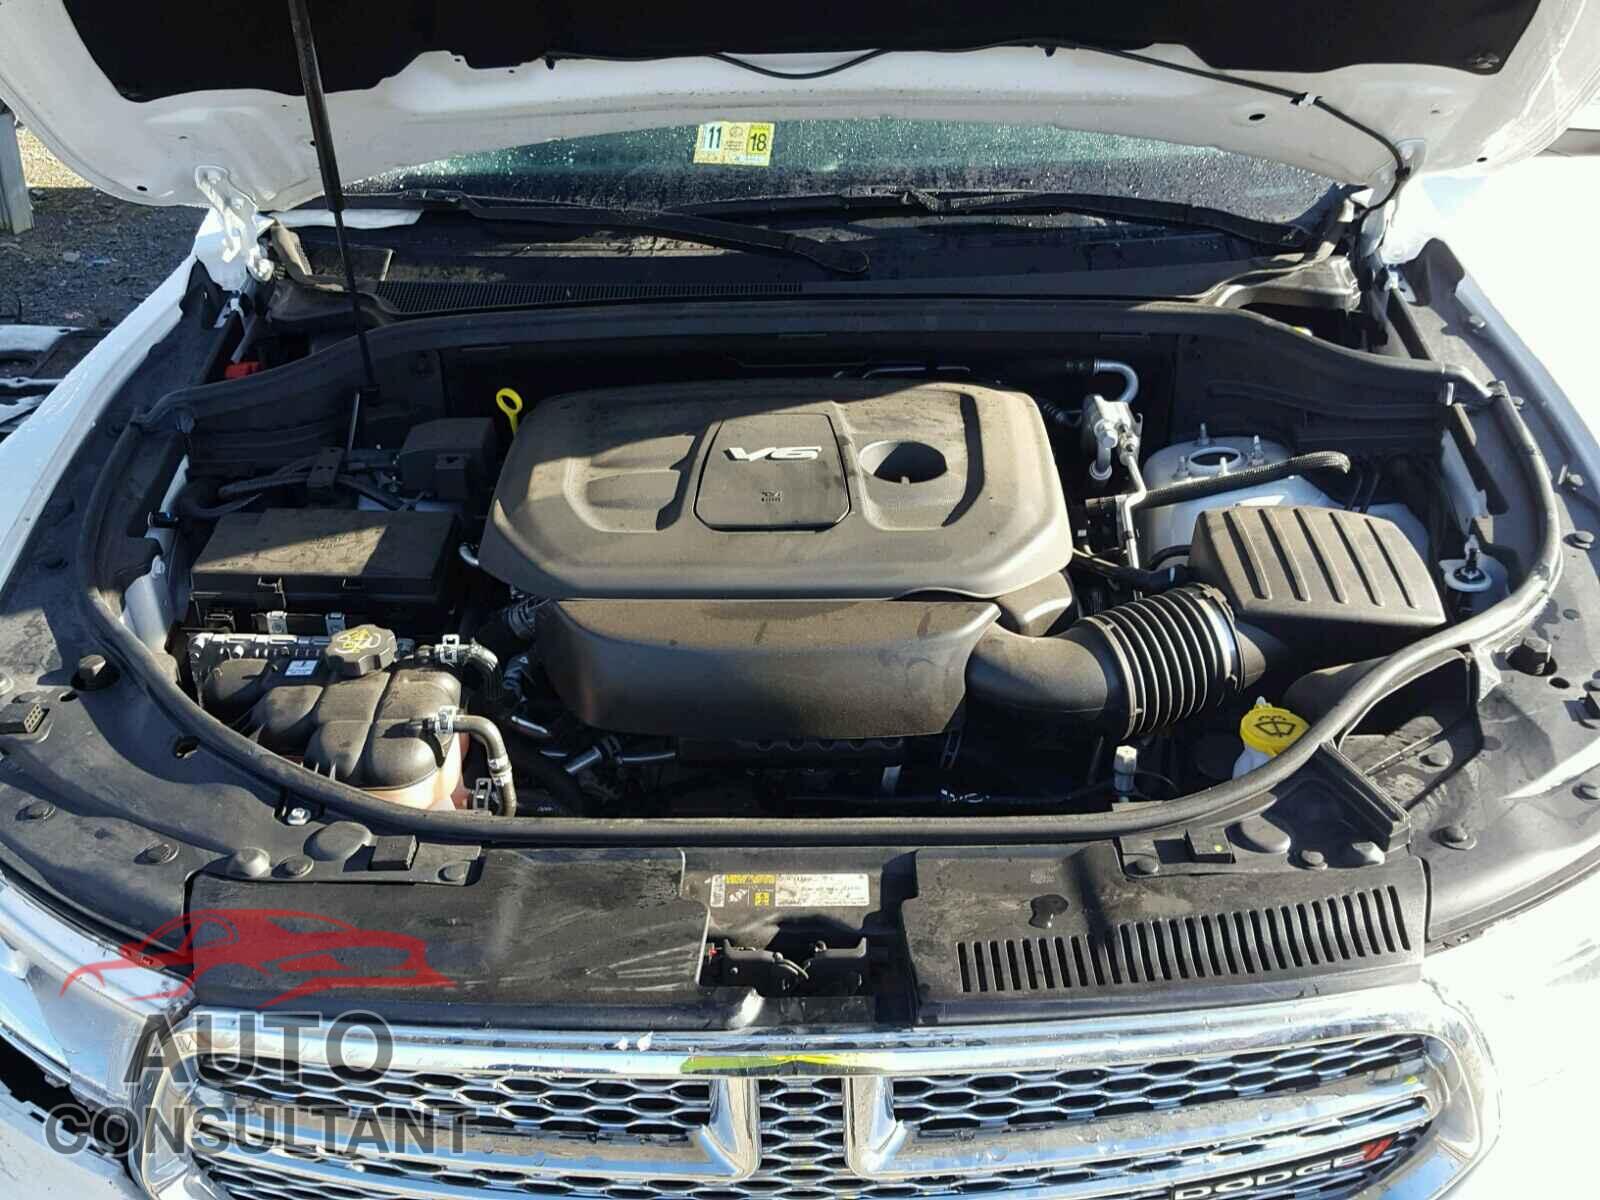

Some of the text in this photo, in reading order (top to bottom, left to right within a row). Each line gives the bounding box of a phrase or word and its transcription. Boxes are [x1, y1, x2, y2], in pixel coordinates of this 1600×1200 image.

[709, 126, 722, 149] 11
[750, 132, 767, 152] 18
[723, 446, 822, 462] V6
[1174, 1151, 1366, 1200] DODGE
